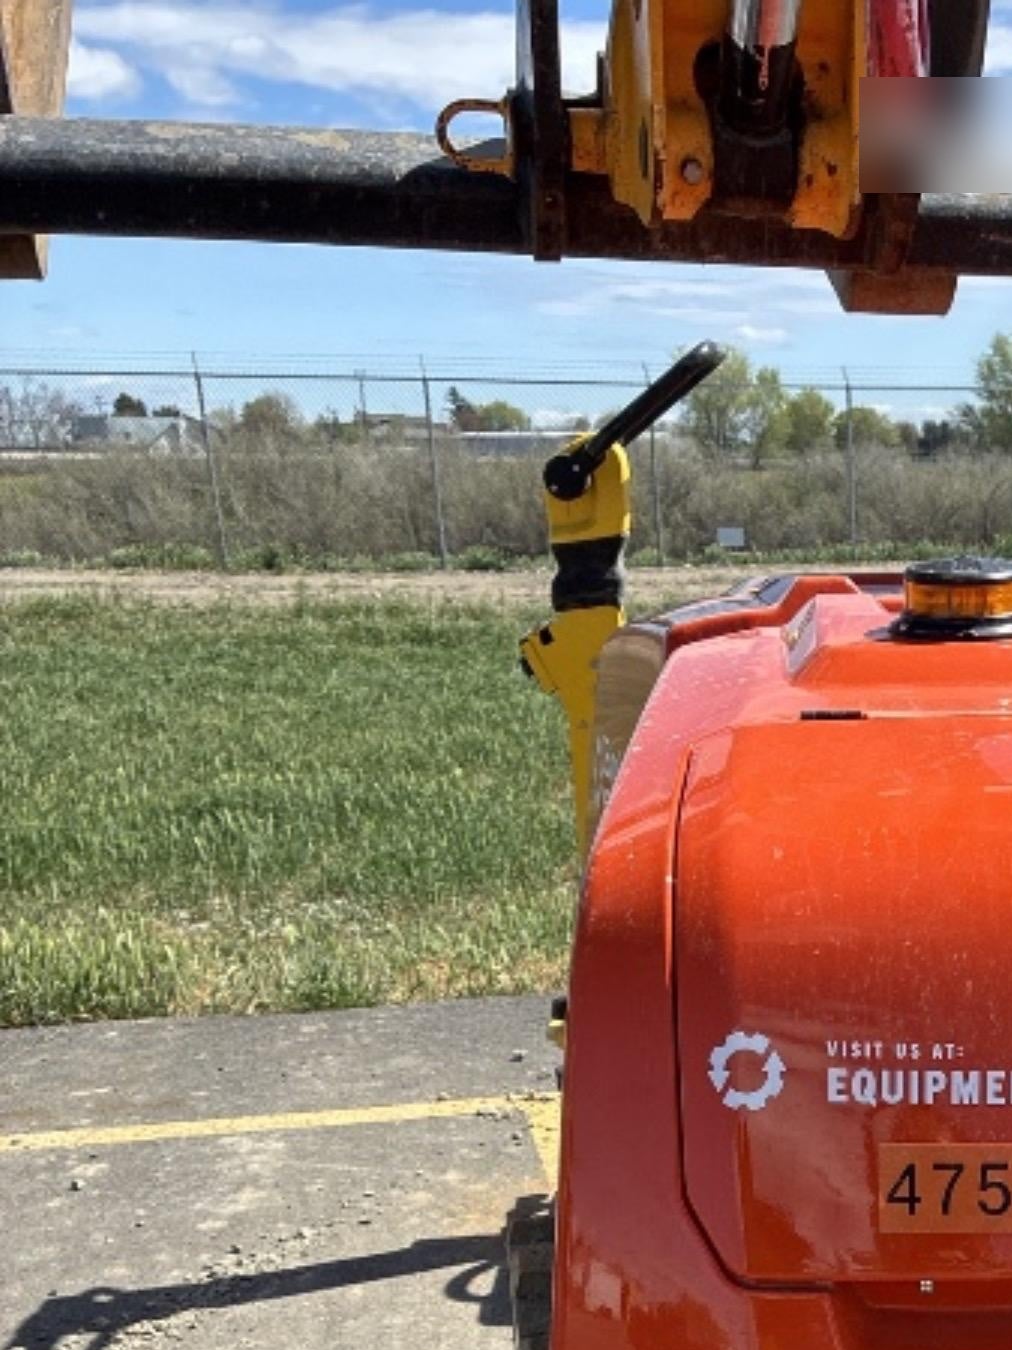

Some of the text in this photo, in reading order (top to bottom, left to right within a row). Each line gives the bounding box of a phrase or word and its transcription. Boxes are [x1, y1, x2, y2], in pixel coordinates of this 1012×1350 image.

[826, 1040, 965, 1060] VISIT US AT:
